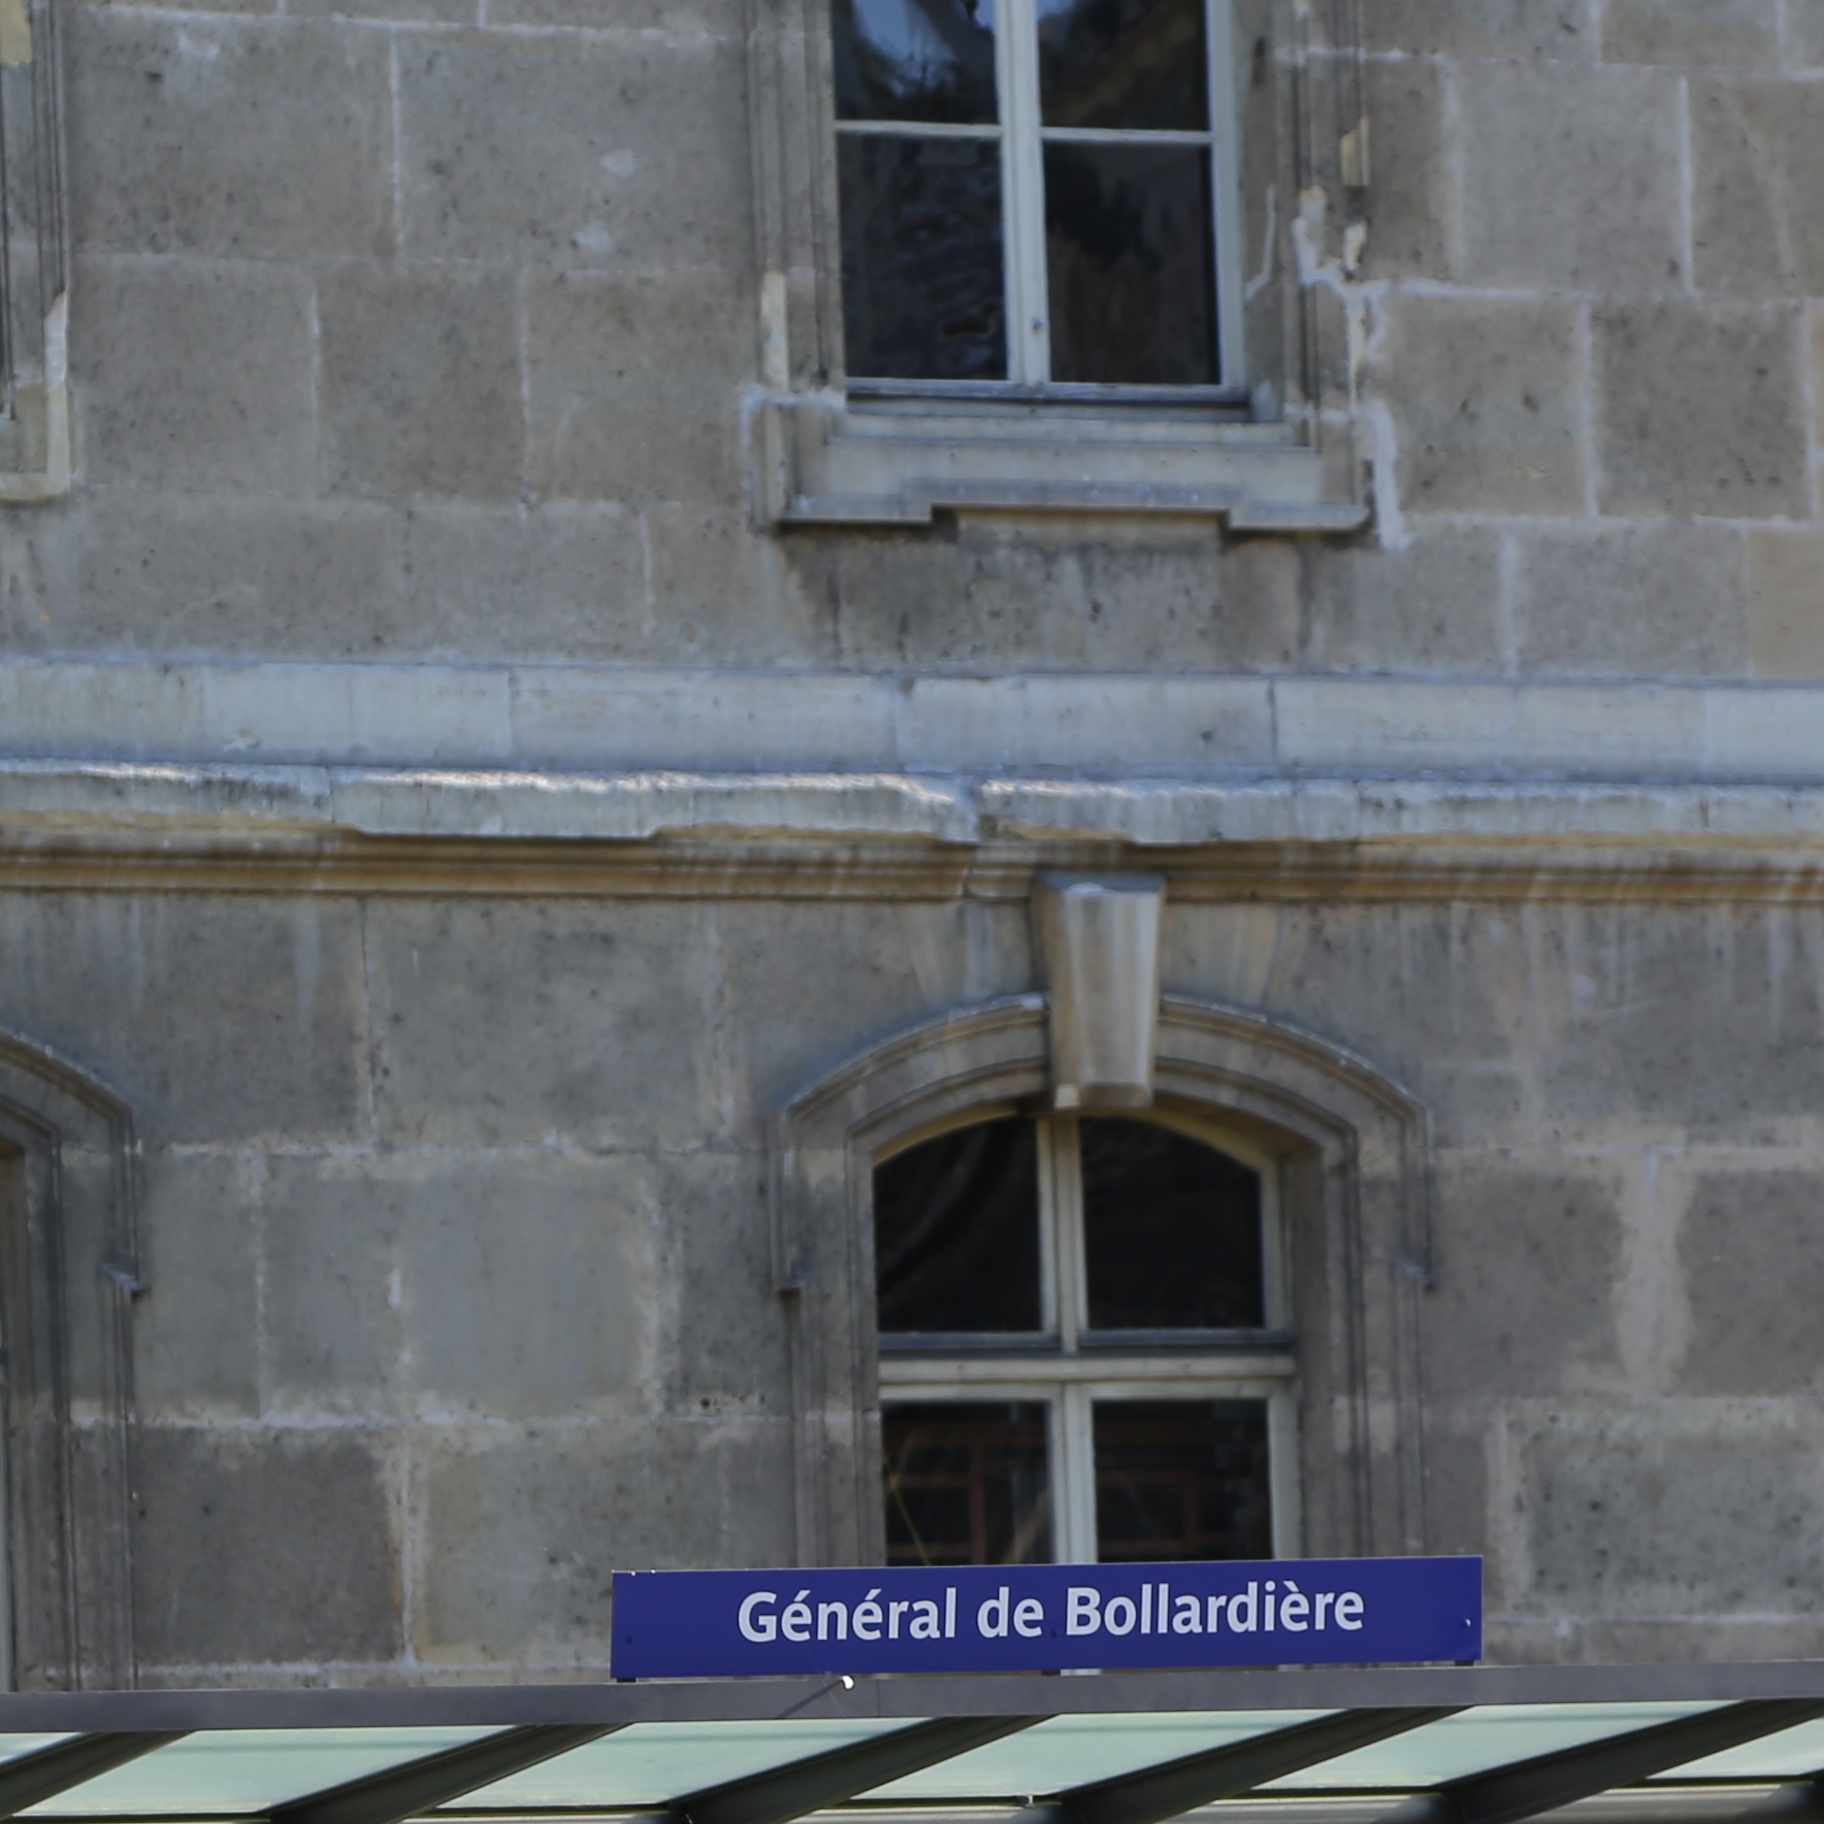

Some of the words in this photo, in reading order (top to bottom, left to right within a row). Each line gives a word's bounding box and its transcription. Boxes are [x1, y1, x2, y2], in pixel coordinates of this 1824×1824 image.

[738, 1587, 957, 1644] Général
[978, 1587, 1045, 1640] de
[1066, 1580, 1365, 1637] Bollardière
